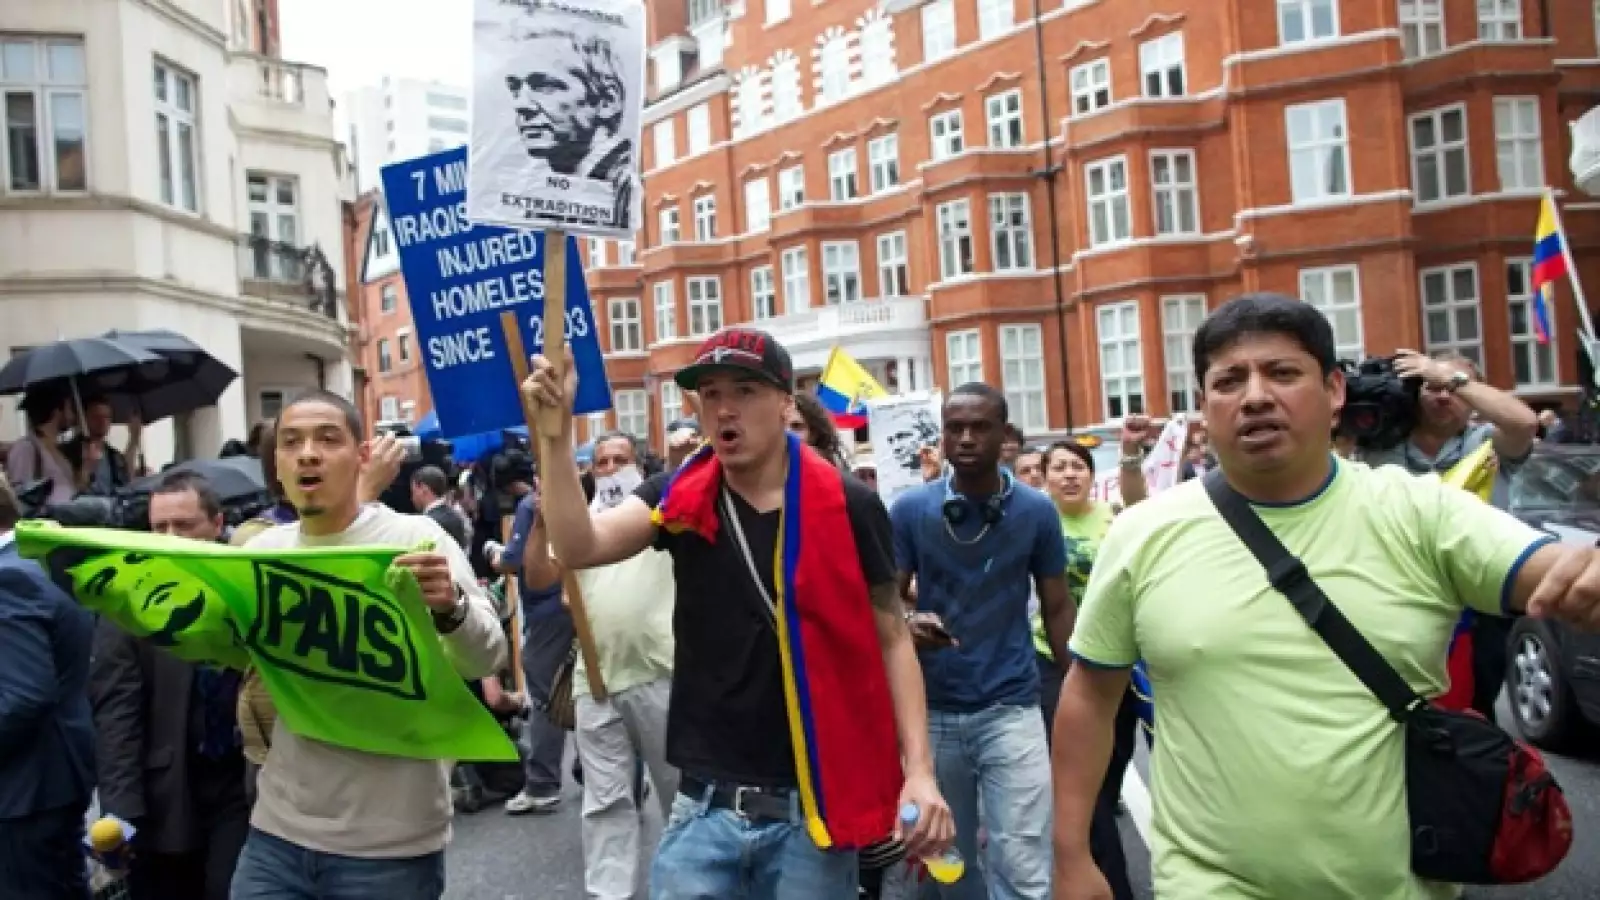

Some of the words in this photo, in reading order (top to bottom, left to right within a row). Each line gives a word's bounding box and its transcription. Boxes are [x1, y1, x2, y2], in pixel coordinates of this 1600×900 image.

[410, 171, 426, 200] 7
[501, 193, 611, 218] EXTRADITION
[546, 177, 569, 190] NO
[394, 203, 472, 246] IRAQIS
[436, 231, 537, 277] INJURED
[430, 268, 545, 320] HOMELES
[427, 327, 496, 369] SINCE
[530, 307, 588, 346] 203
[263, 572, 406, 683] PAIS
